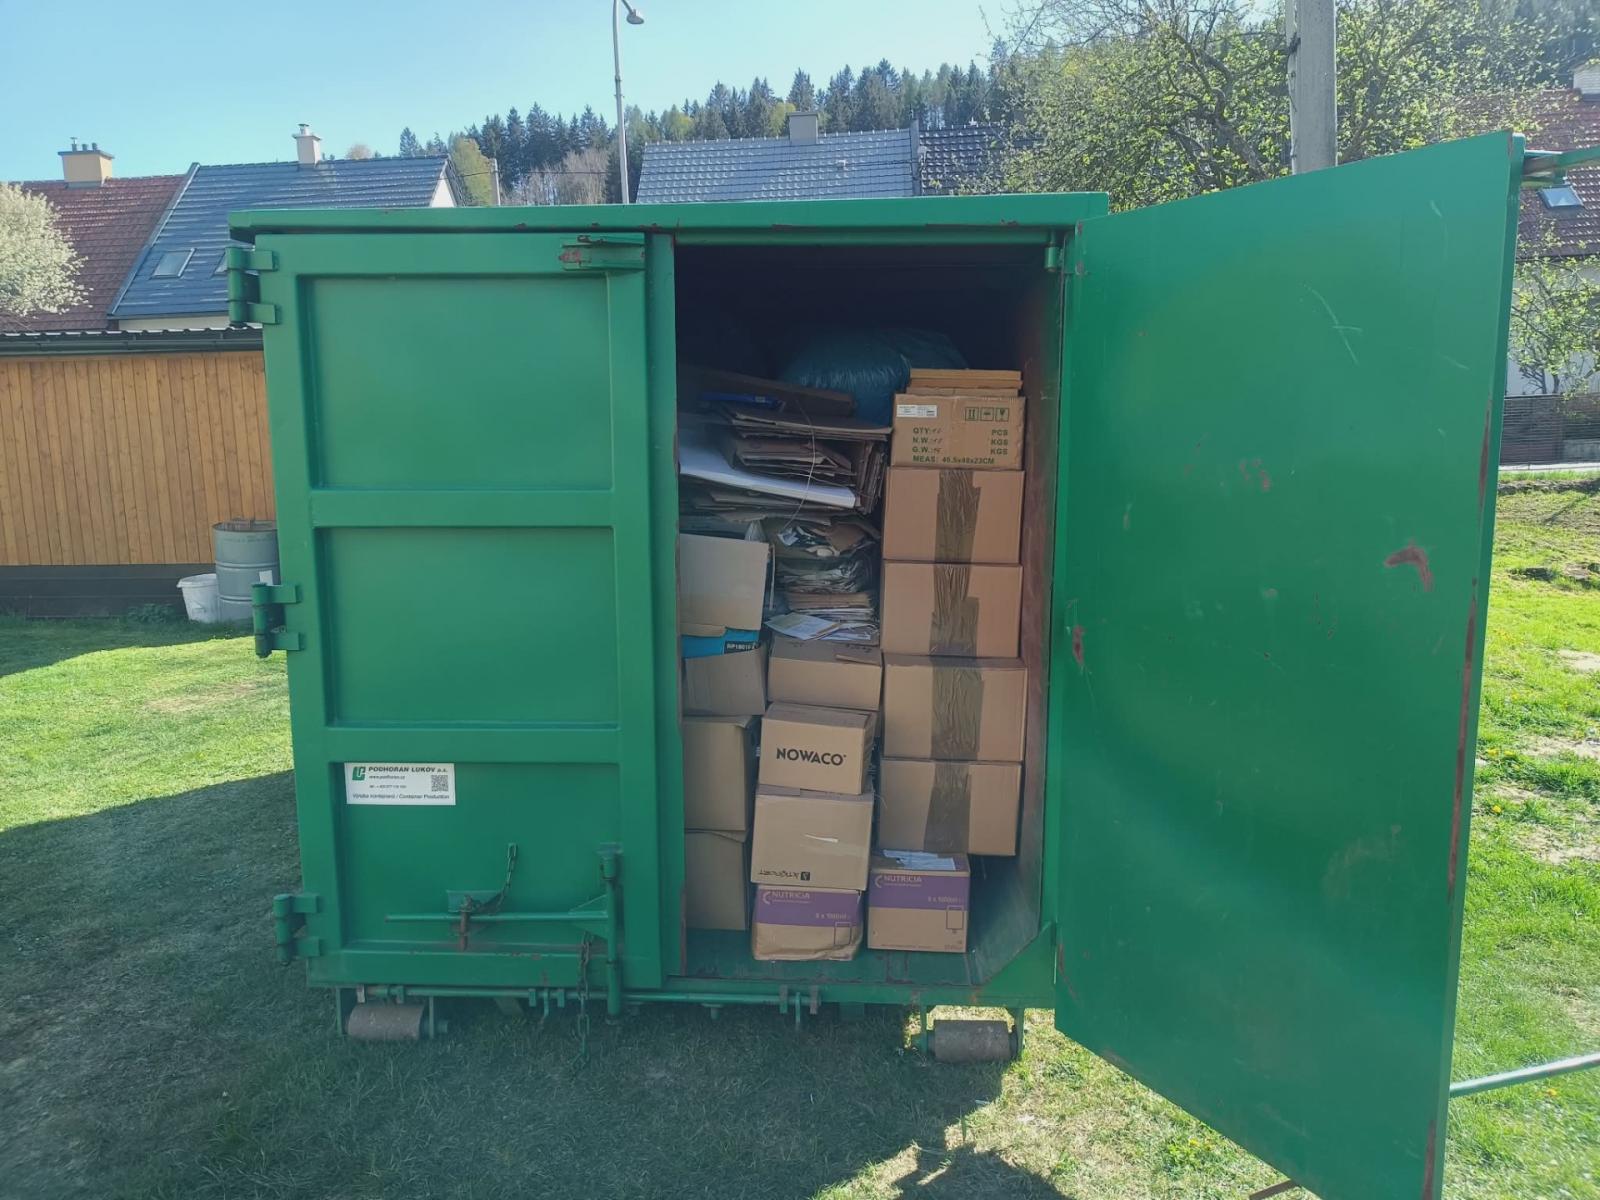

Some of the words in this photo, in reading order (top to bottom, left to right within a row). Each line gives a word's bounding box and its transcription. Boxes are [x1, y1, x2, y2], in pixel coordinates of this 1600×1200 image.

[776, 747, 844, 766] NOWACO
[883, 875, 922, 883] NUTRICIA
[771, 890, 811, 899] NUTRICIA
